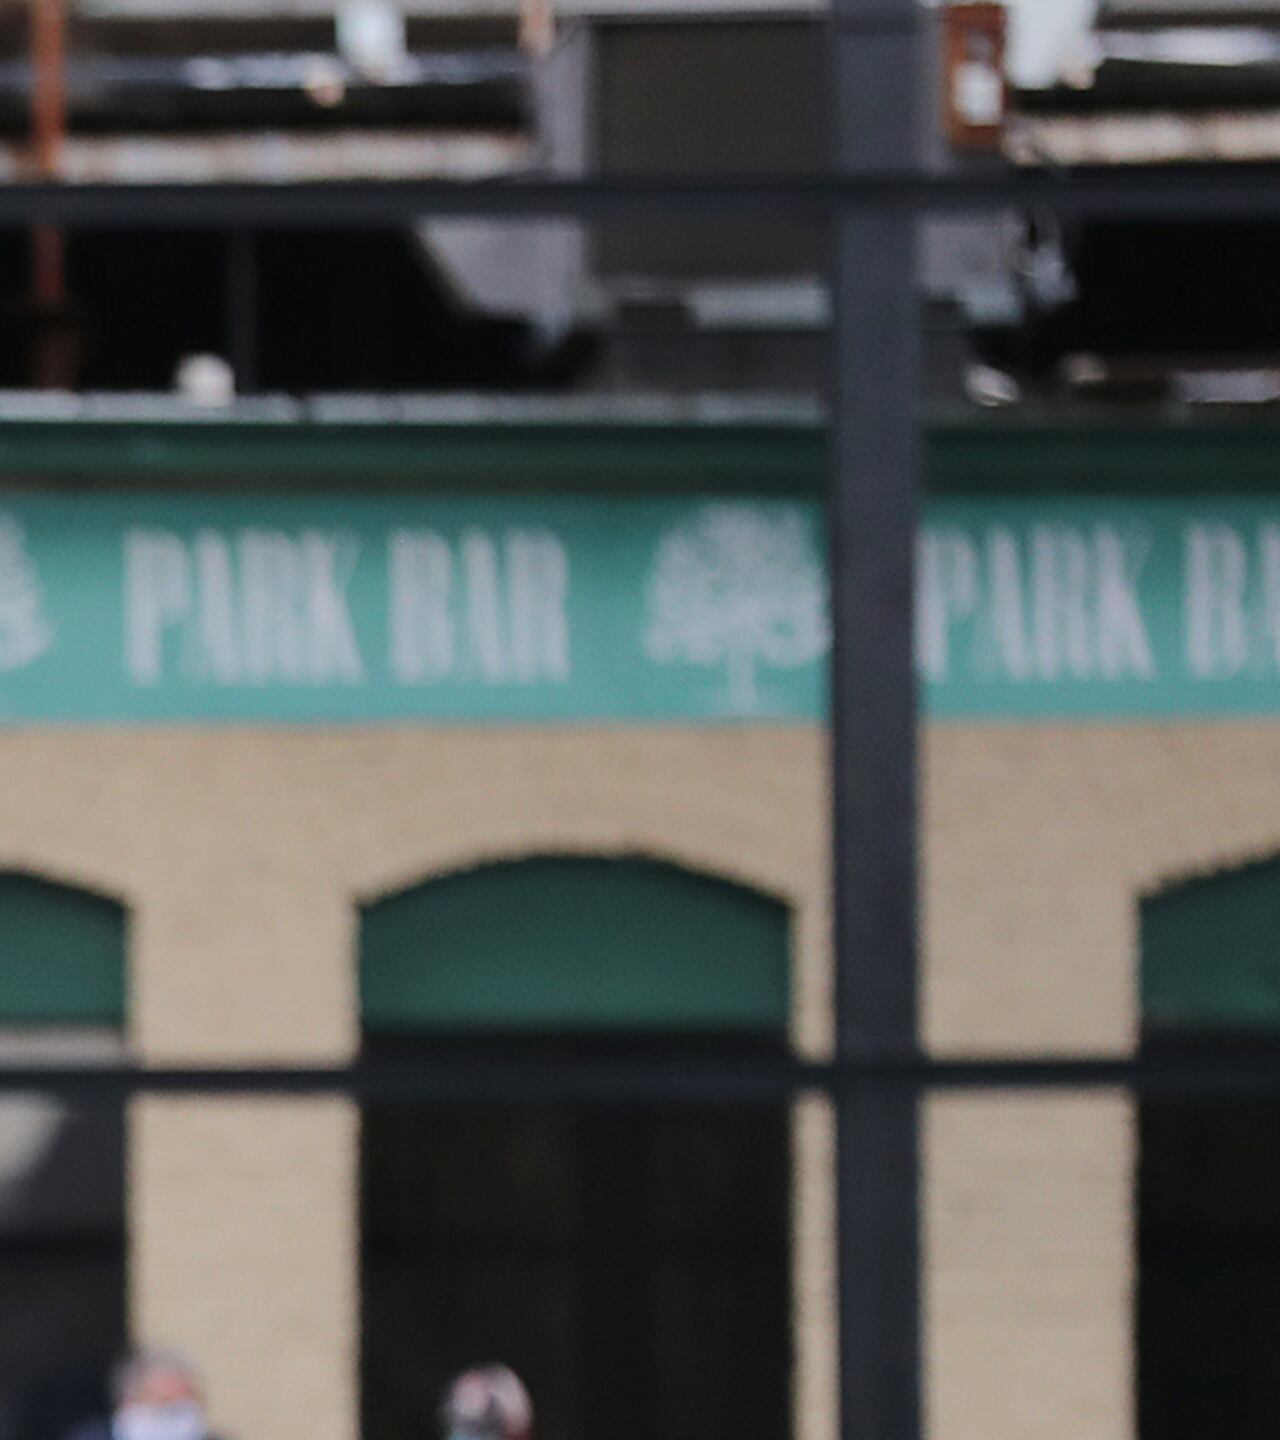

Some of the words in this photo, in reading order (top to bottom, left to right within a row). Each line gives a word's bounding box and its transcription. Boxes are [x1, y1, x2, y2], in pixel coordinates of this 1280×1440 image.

[122, 525, 364, 687] PARK
[386, 526, 572, 687] BAR
[913, 523, 1156, 684] PARK
